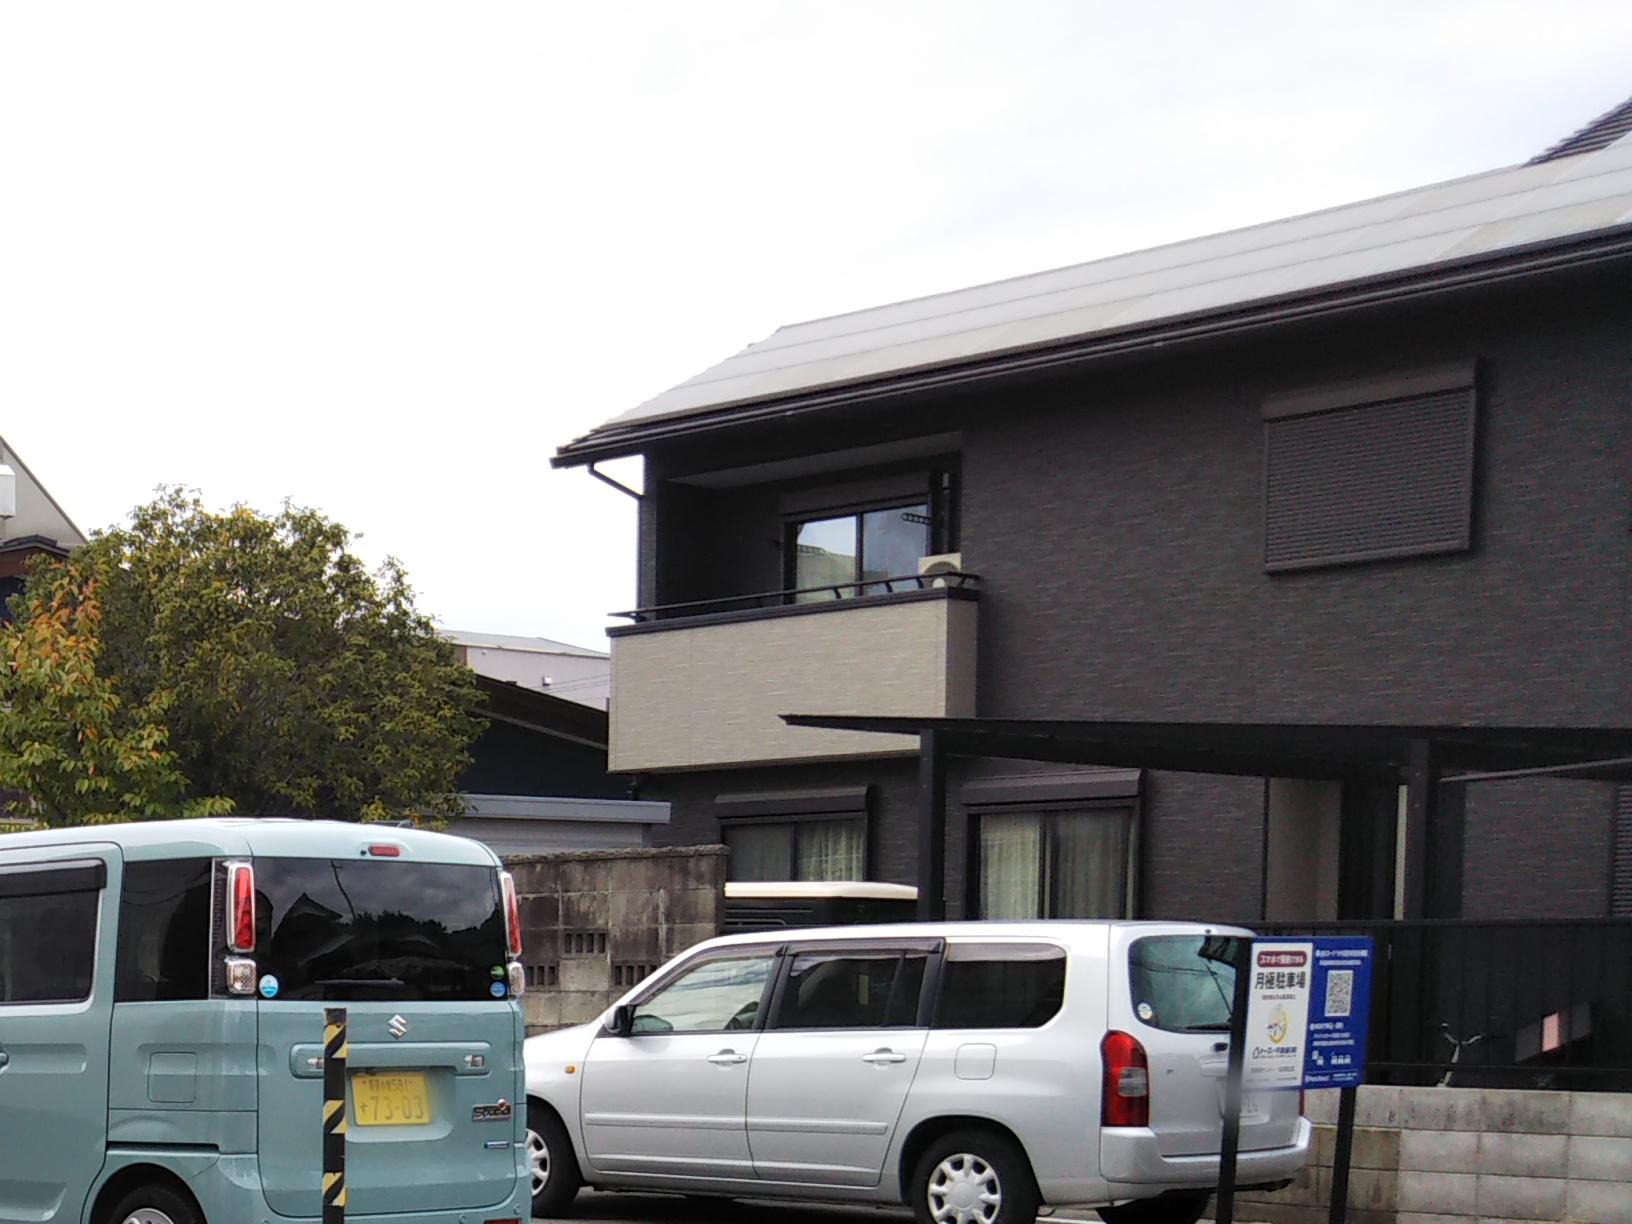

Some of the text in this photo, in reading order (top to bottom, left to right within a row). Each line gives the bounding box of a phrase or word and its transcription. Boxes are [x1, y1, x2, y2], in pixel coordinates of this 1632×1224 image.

[1255, 971, 1306, 990] 月極駐車場
